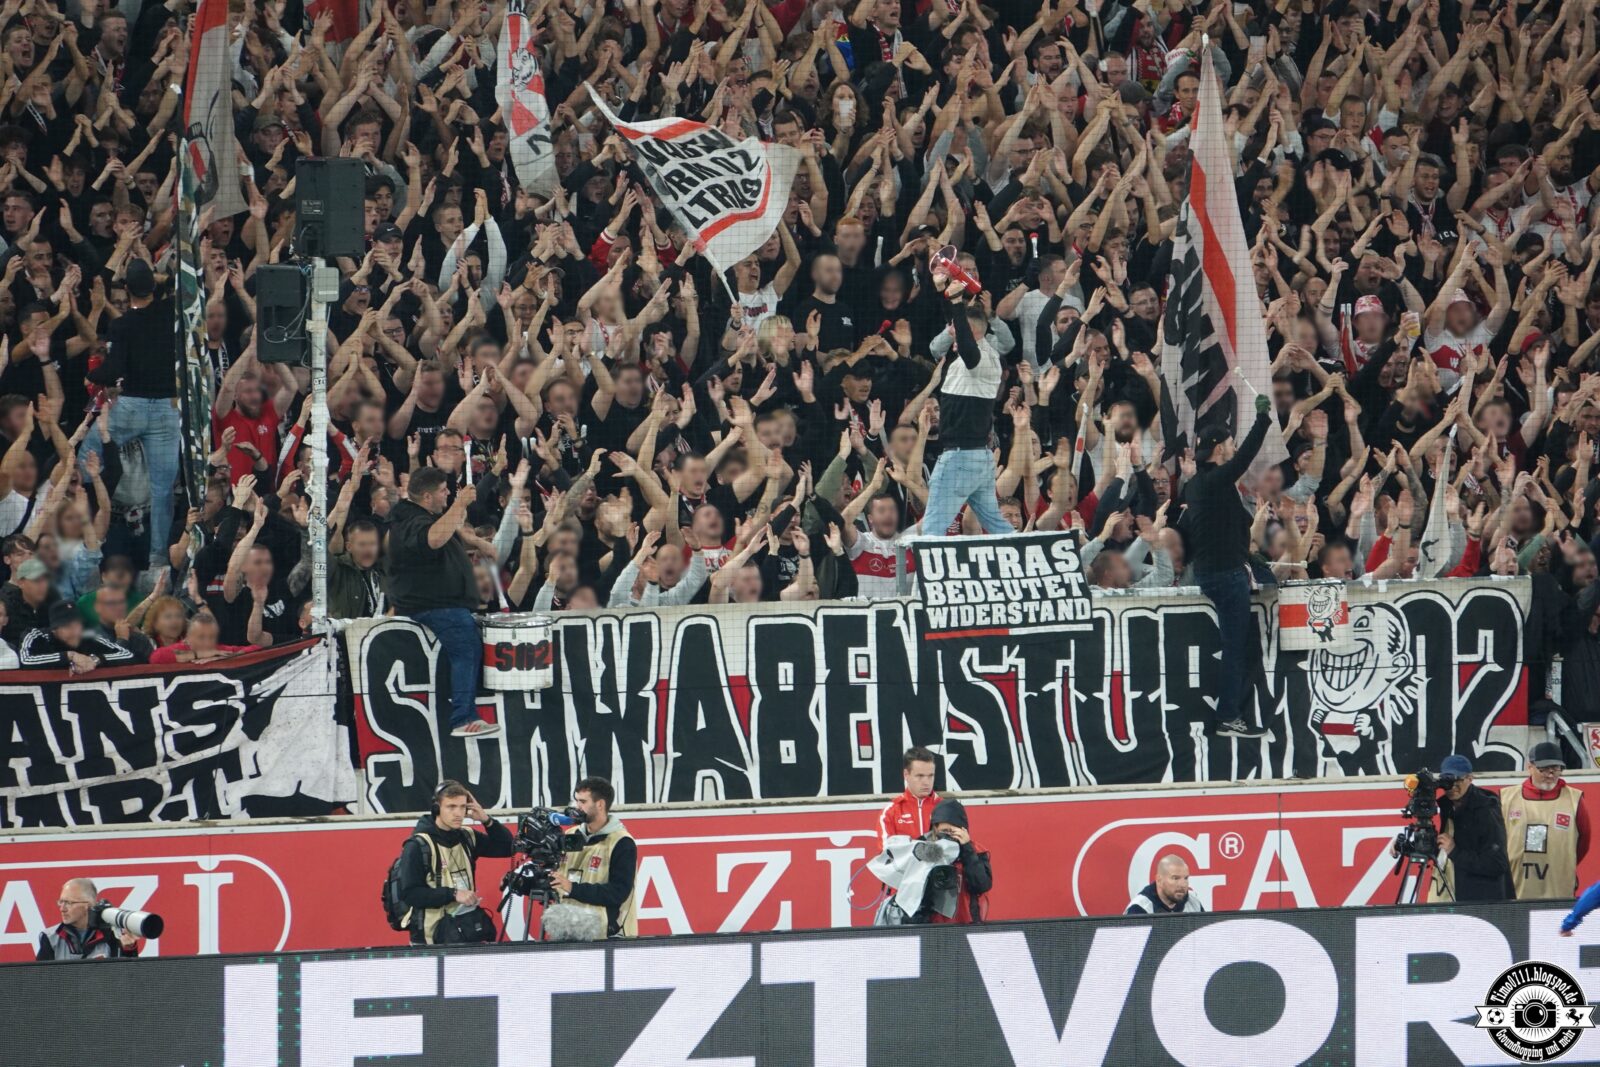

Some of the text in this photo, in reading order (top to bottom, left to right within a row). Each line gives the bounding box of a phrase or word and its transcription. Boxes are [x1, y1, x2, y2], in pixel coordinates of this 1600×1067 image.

[919, 539, 1080, 581] ULTRAS
[924, 572, 1085, 606] BEDEUTET
[926, 597, 1092, 629] WIDERSTAND
[1522, 863, 1549, 880] TV
